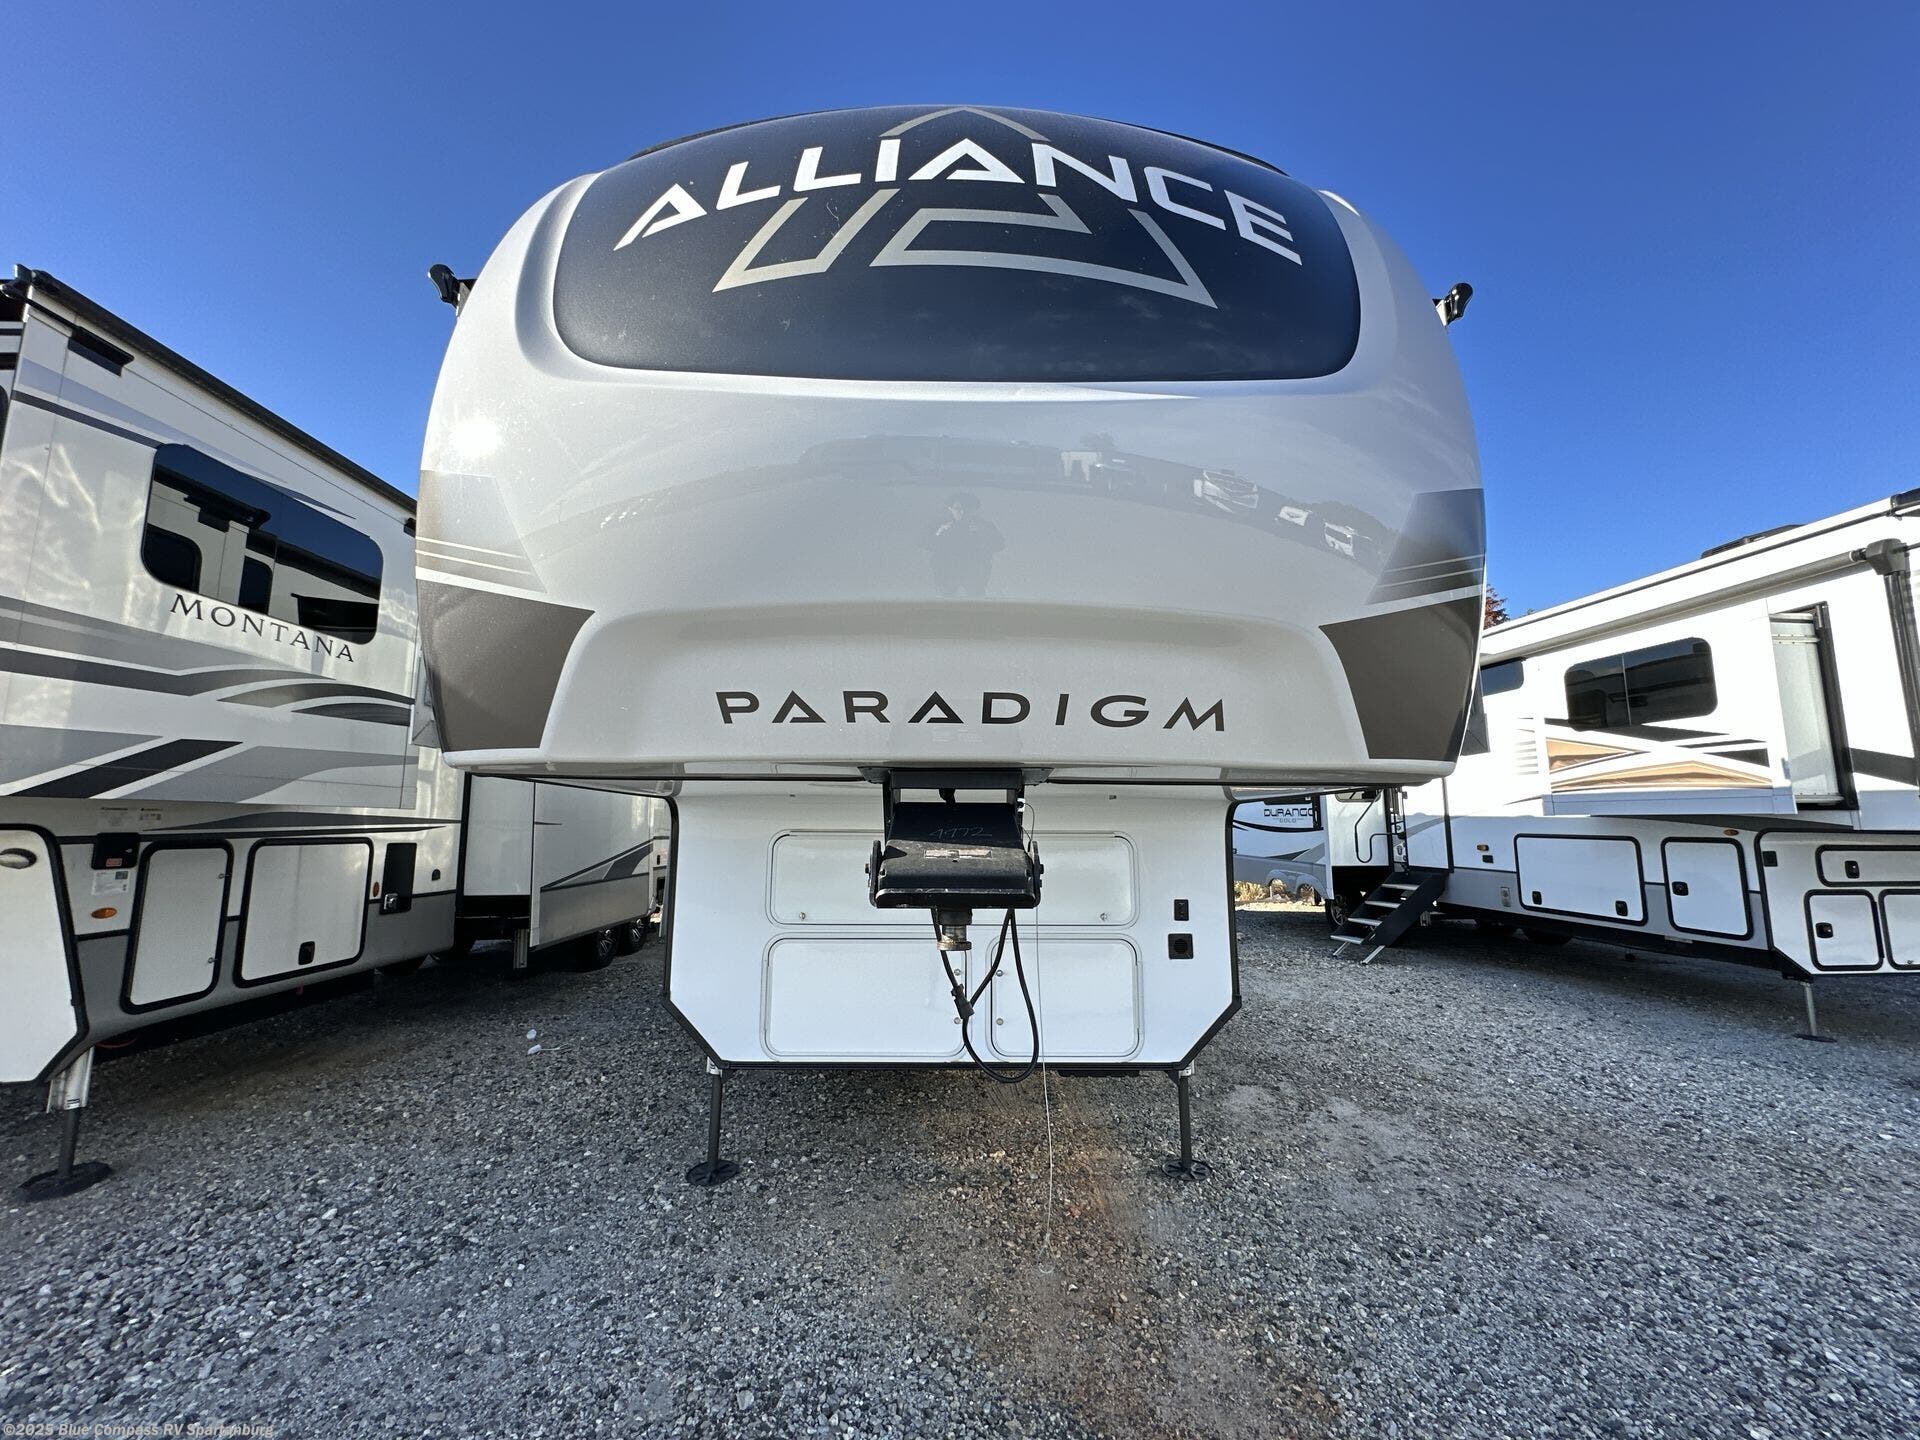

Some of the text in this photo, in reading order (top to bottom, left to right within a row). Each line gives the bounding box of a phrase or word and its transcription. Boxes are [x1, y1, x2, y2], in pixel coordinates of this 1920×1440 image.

[613, 138, 1302, 266] ALLIANCE
[170, 593, 354, 662] MONTANA
[716, 690, 1225, 731] PARADIGM
